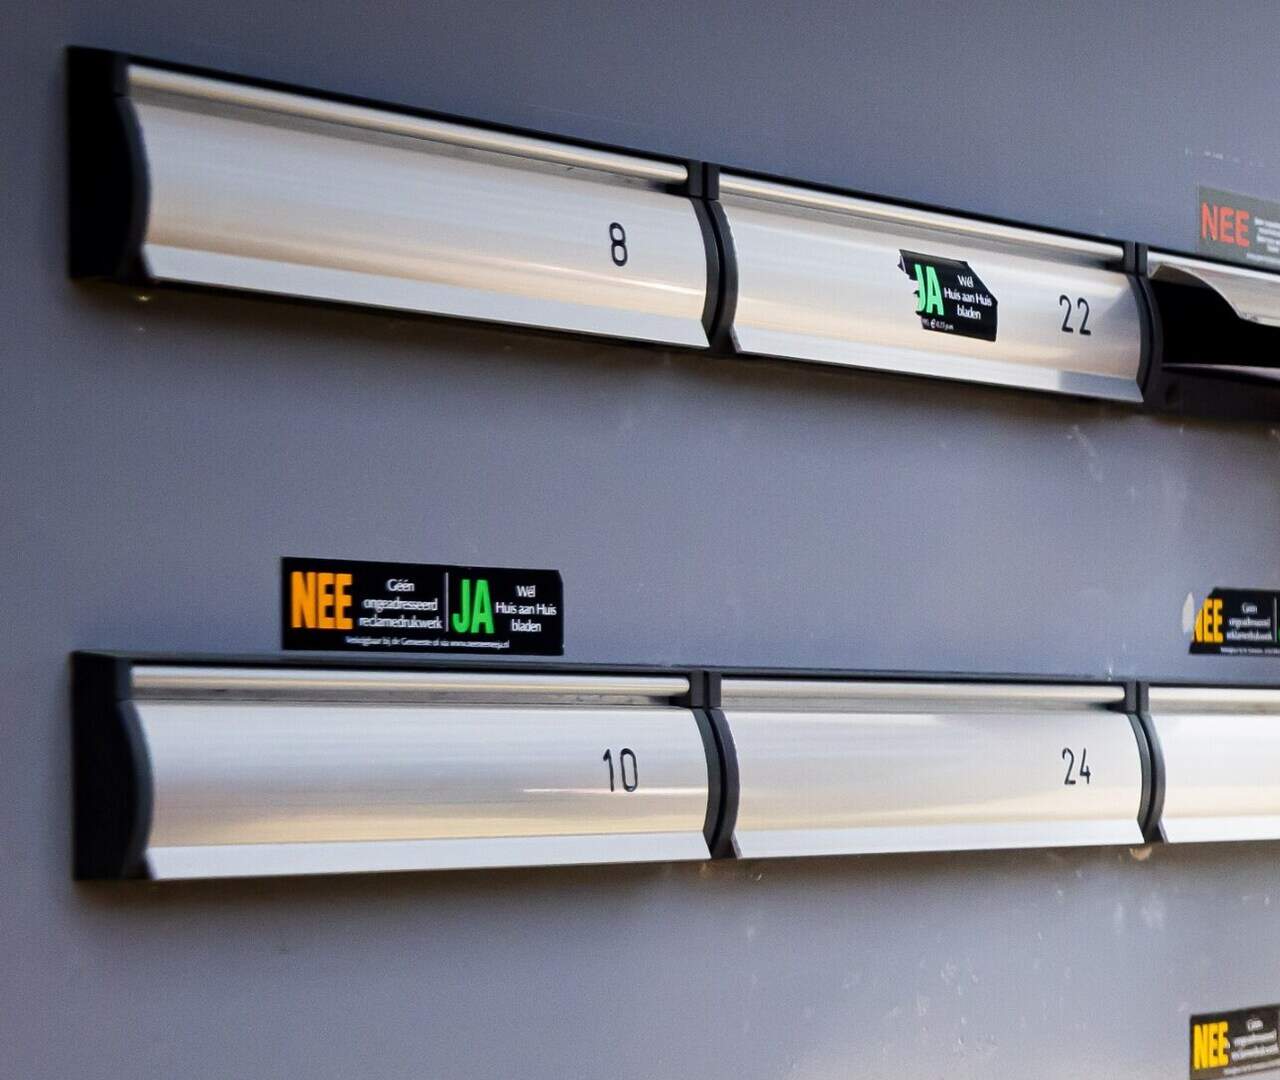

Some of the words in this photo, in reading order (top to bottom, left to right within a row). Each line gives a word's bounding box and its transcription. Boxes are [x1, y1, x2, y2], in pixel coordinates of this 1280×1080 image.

[1201, 200, 1250, 248] NEE
[609, 222, 628, 267] 8
[944, 287, 961, 301] Huis
[962, 293, 975, 303] aan
[976, 293, 993, 307] Huis
[957, 304, 982, 320] bladen
[1060, 294, 1092, 336] 22
[291, 571, 352, 630] NEE
[386, 578, 415, 592] Géén
[358, 613, 443, 629] reclamedrukwerk
[363, 596, 438, 613] ongeadresseerd
[452, 579, 495, 634] JA
[495, 601, 517, 615] Huis
[518, 604, 535, 615] aan
[536, 603, 557, 616] Huis
[511, 618, 542, 632] bladen
[603, 748, 638, 792] 10
[1062, 748, 1091, 785] 24
[1194, 1021, 1229, 1070] NEE
